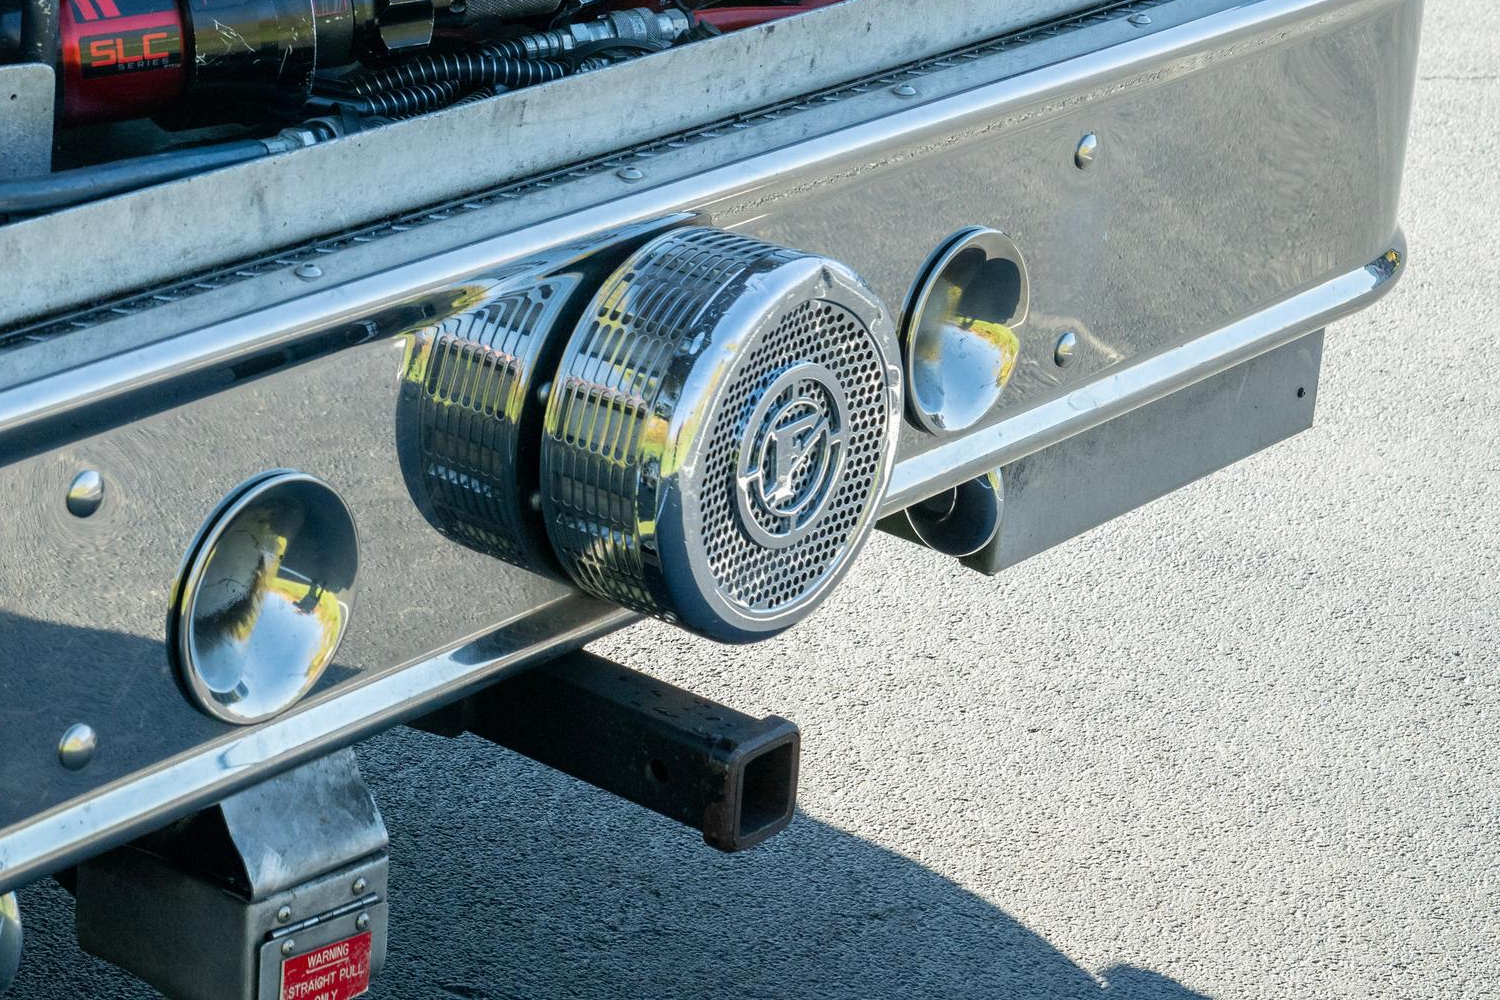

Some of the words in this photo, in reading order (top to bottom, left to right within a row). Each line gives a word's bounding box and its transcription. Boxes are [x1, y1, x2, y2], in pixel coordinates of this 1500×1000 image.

[89, 32, 170, 67] SLC
[118, 57, 170, 70] SERIES
[307, 943, 350, 968] WARNING
[288, 971, 337, 999] STRAIGHT
[340, 963, 365, 981] PULL
